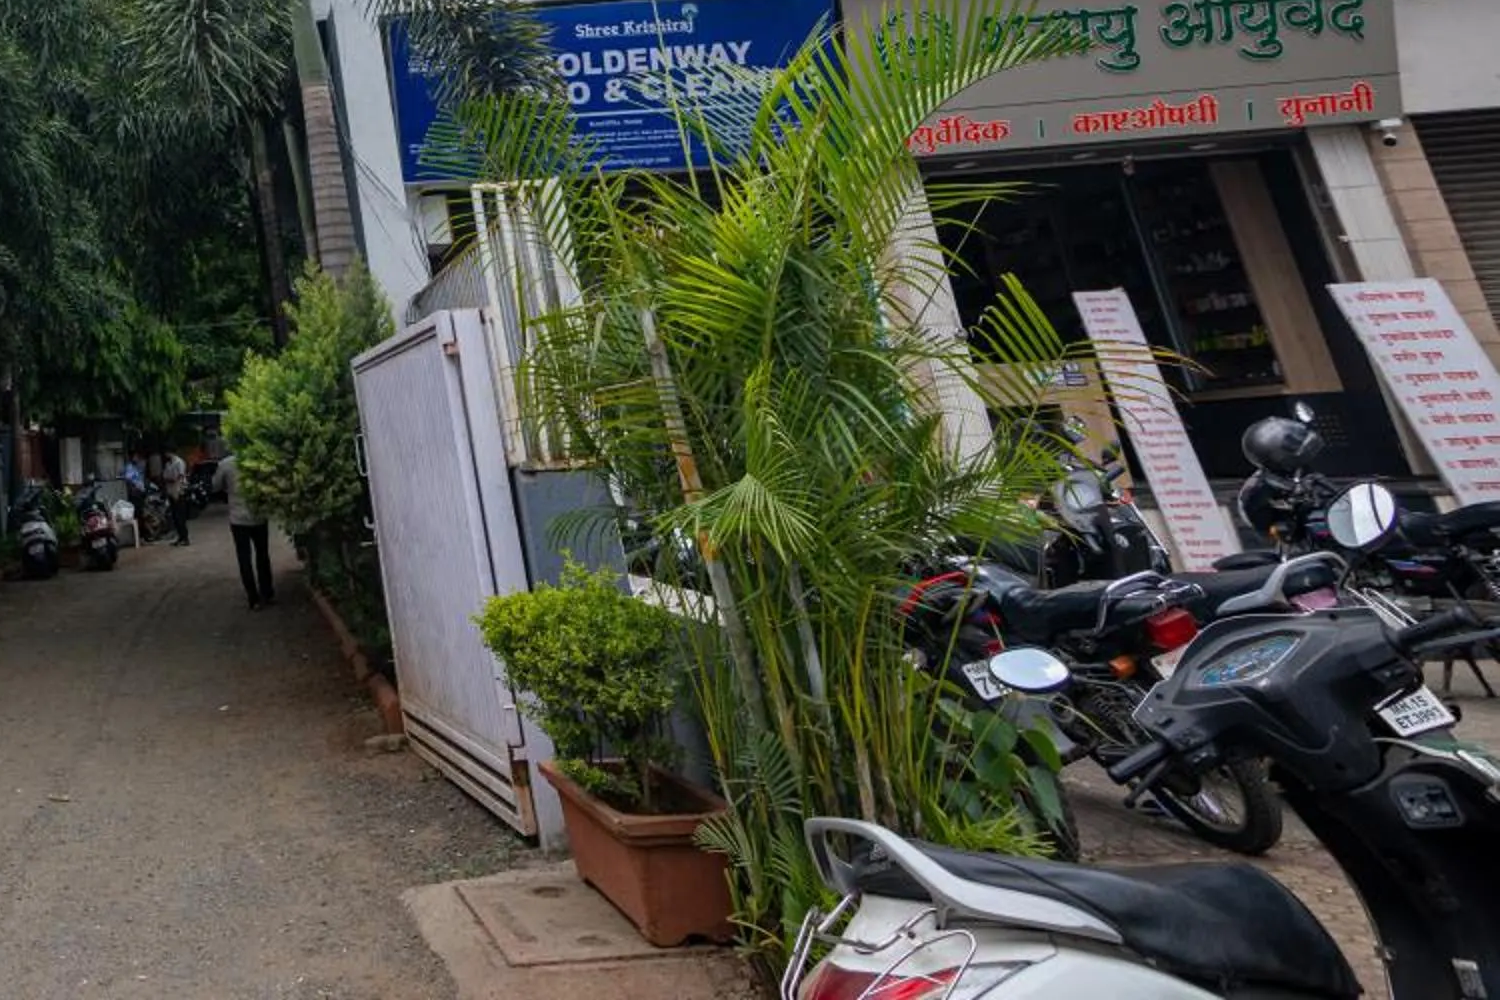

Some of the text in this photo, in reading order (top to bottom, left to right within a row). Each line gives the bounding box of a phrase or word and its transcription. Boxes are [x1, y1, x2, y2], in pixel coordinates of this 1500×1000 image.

[575, 16, 697, 38] Shree Krishiraj
[556, 40, 752, 78] OLDENWAY
[603, 78, 629, 103] &
[905, 115, 1012, 153] युर्वेदिक
[1275, 81, 1374, 127] युनानी
